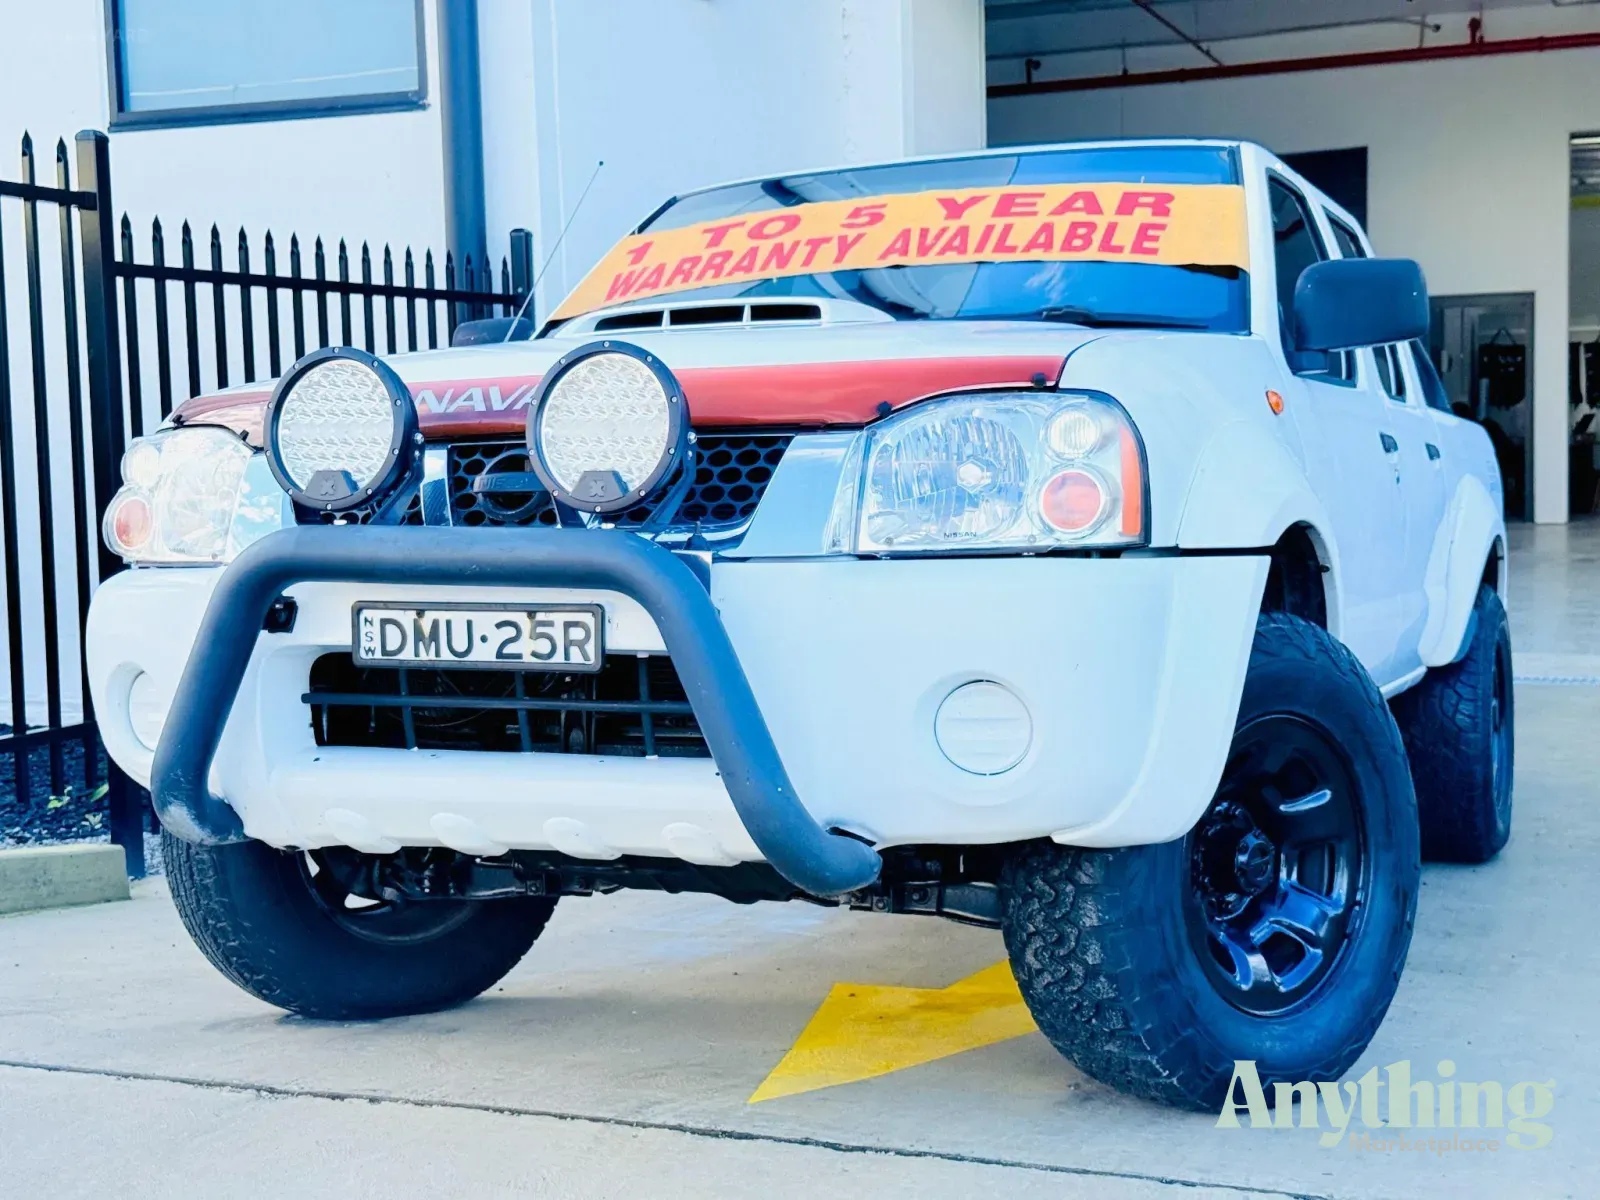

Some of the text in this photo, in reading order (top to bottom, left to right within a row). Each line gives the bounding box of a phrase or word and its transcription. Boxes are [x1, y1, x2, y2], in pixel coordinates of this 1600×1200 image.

[604, 221, 1168, 302] WARRANTY AVAILABLE
[627, 191, 1176, 266] 1 TO 5 YEAR
[943, 531, 977, 539] NISSAN
